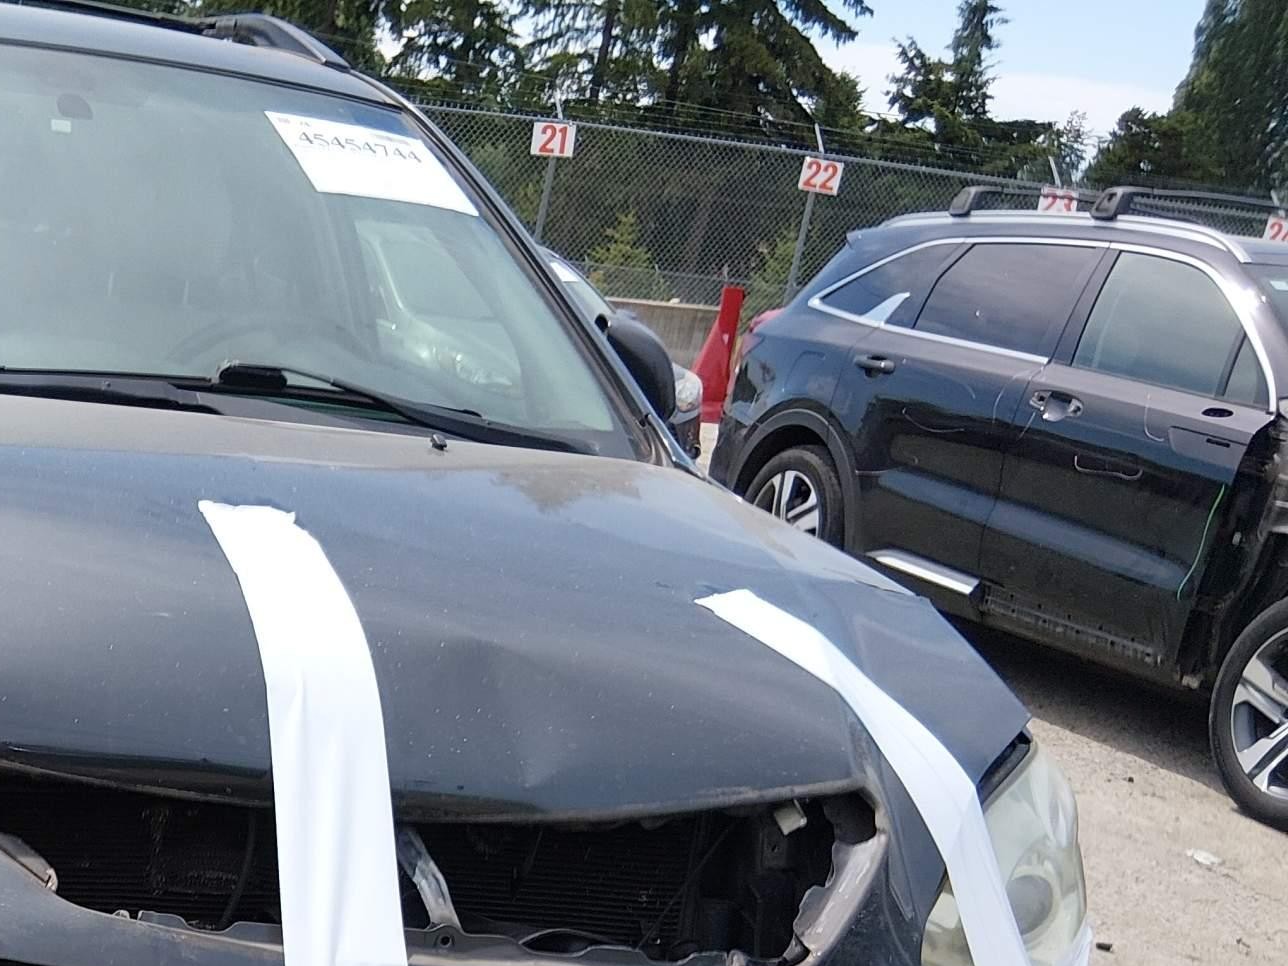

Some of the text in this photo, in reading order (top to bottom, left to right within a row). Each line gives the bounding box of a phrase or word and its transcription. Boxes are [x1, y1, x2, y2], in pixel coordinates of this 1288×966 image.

[299, 132, 422, 163] 45454744
[538, 124, 568, 154] 21
[802, 160, 838, 190] 22
